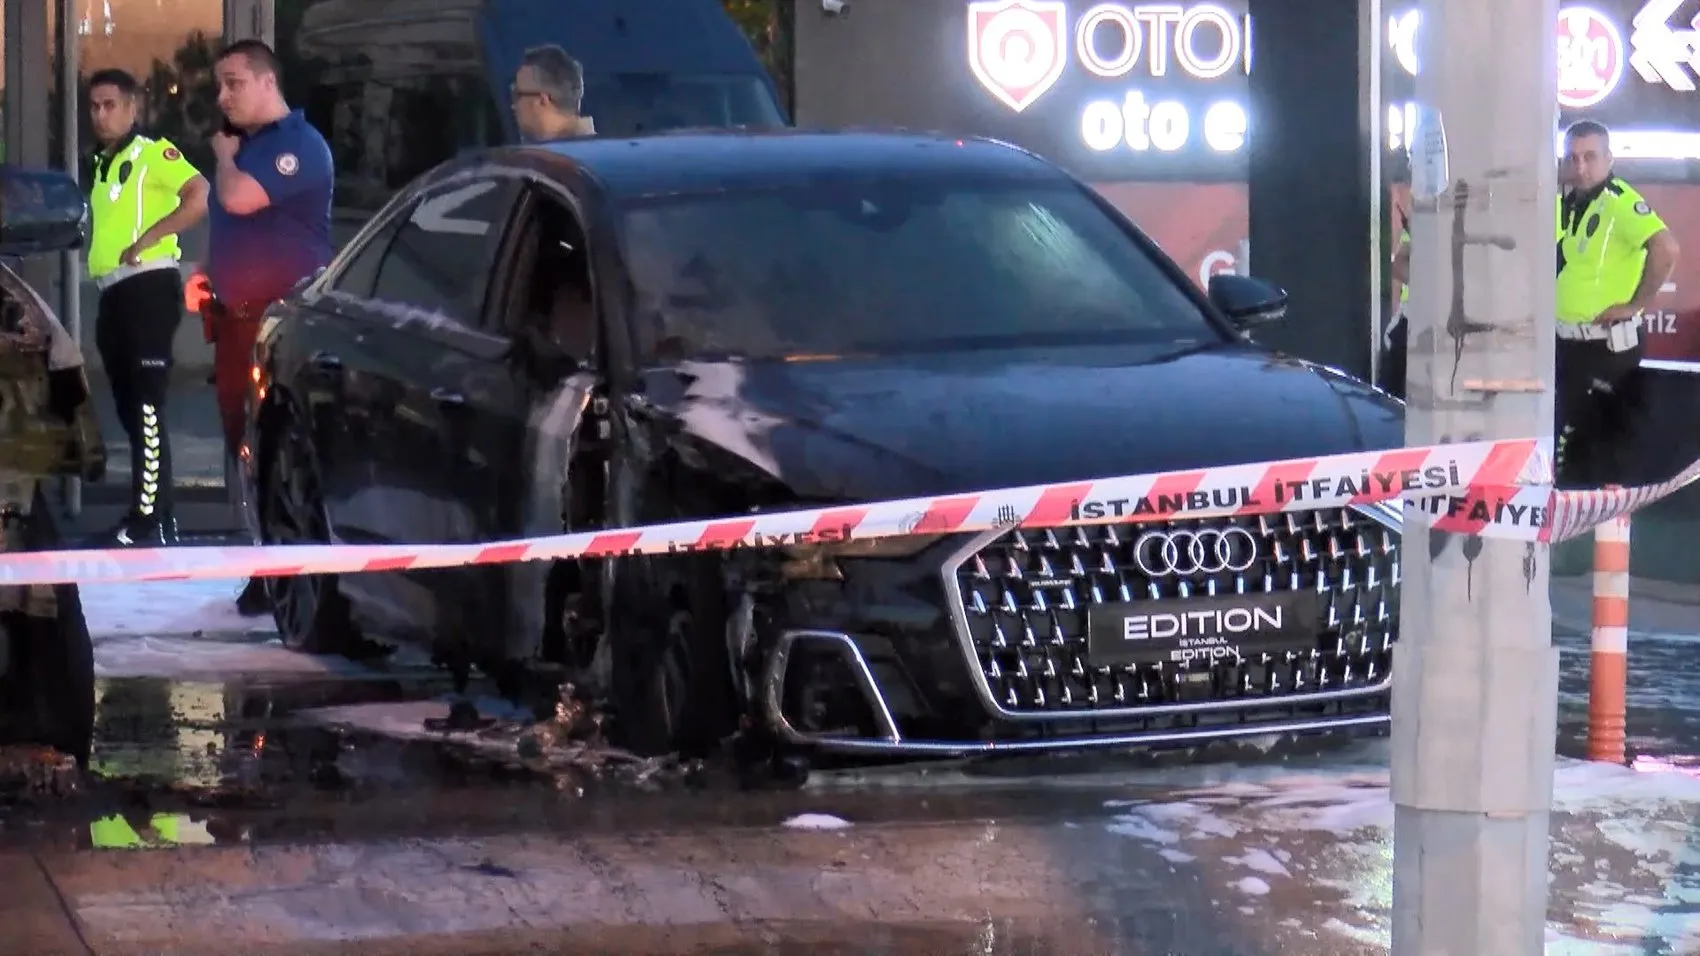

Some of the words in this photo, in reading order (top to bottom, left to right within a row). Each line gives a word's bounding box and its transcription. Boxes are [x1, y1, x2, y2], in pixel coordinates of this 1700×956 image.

[1082, 90, 1190, 151] oto
[1071, 486, 1261, 521] İSTANBUL
[1274, 460, 1460, 504] İTFAİYESİ
[1124, 605, 1282, 640] EDITION
[1171, 644, 1240, 662] EDITION
